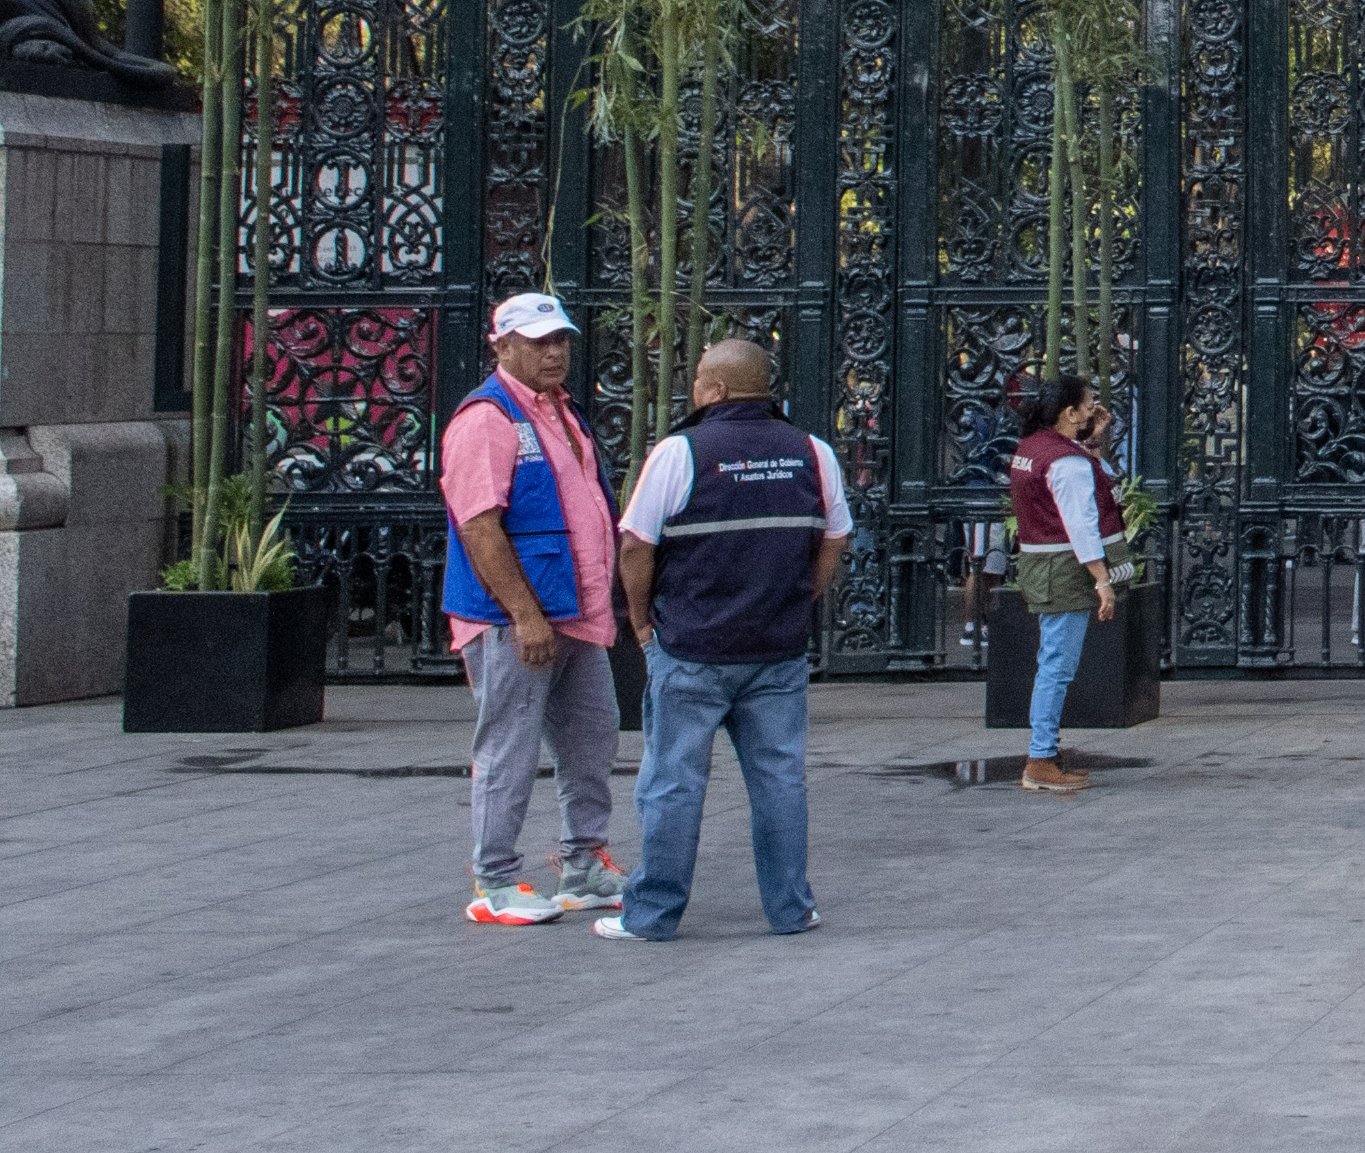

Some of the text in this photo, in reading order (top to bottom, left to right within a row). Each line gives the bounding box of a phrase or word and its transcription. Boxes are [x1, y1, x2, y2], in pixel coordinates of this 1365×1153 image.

[746, 459, 768, 469] General
[770, 459, 778, 468] de
[740, 472, 765, 482] Asuntos
[766, 469, 793, 480] Jurídicos
